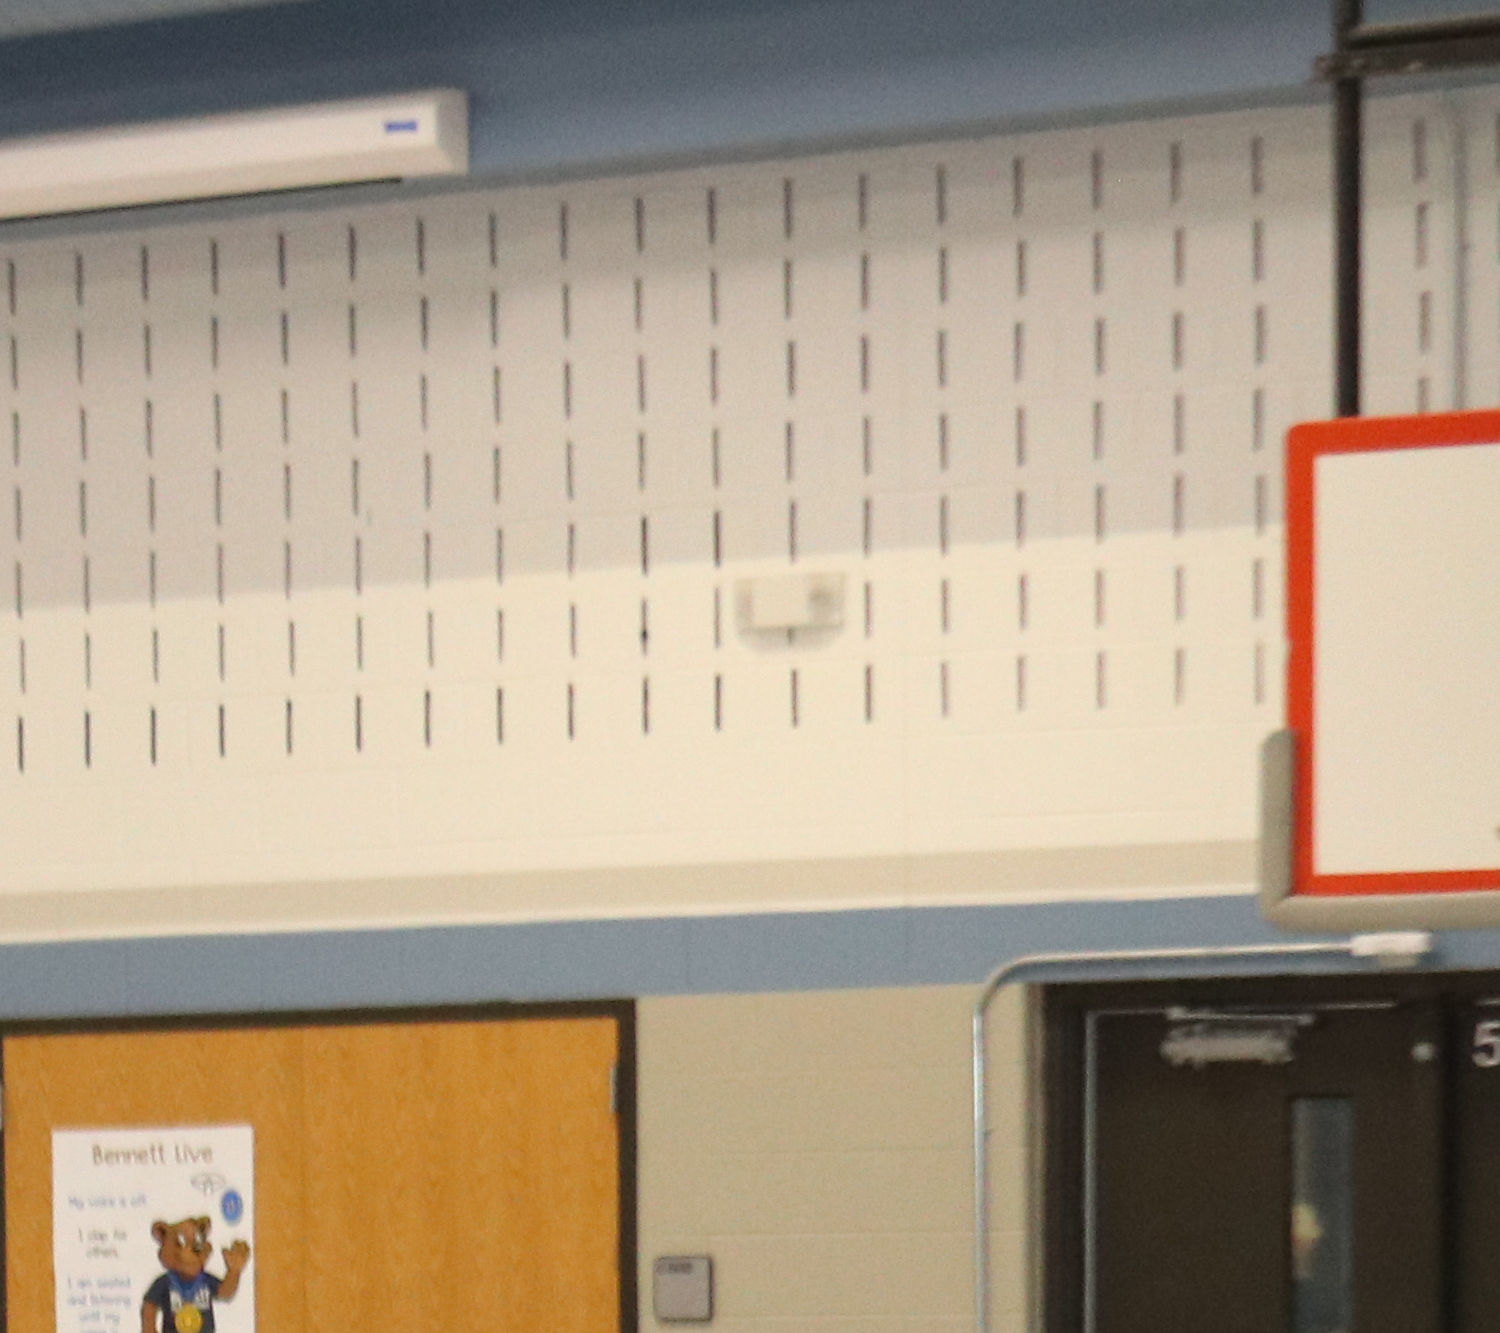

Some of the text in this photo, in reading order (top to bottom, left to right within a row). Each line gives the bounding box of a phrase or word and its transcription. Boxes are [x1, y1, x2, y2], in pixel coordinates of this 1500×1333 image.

[1471, 1021, 1500, 1068] 5
[92, 1143, 213, 1166] Bennett Live
